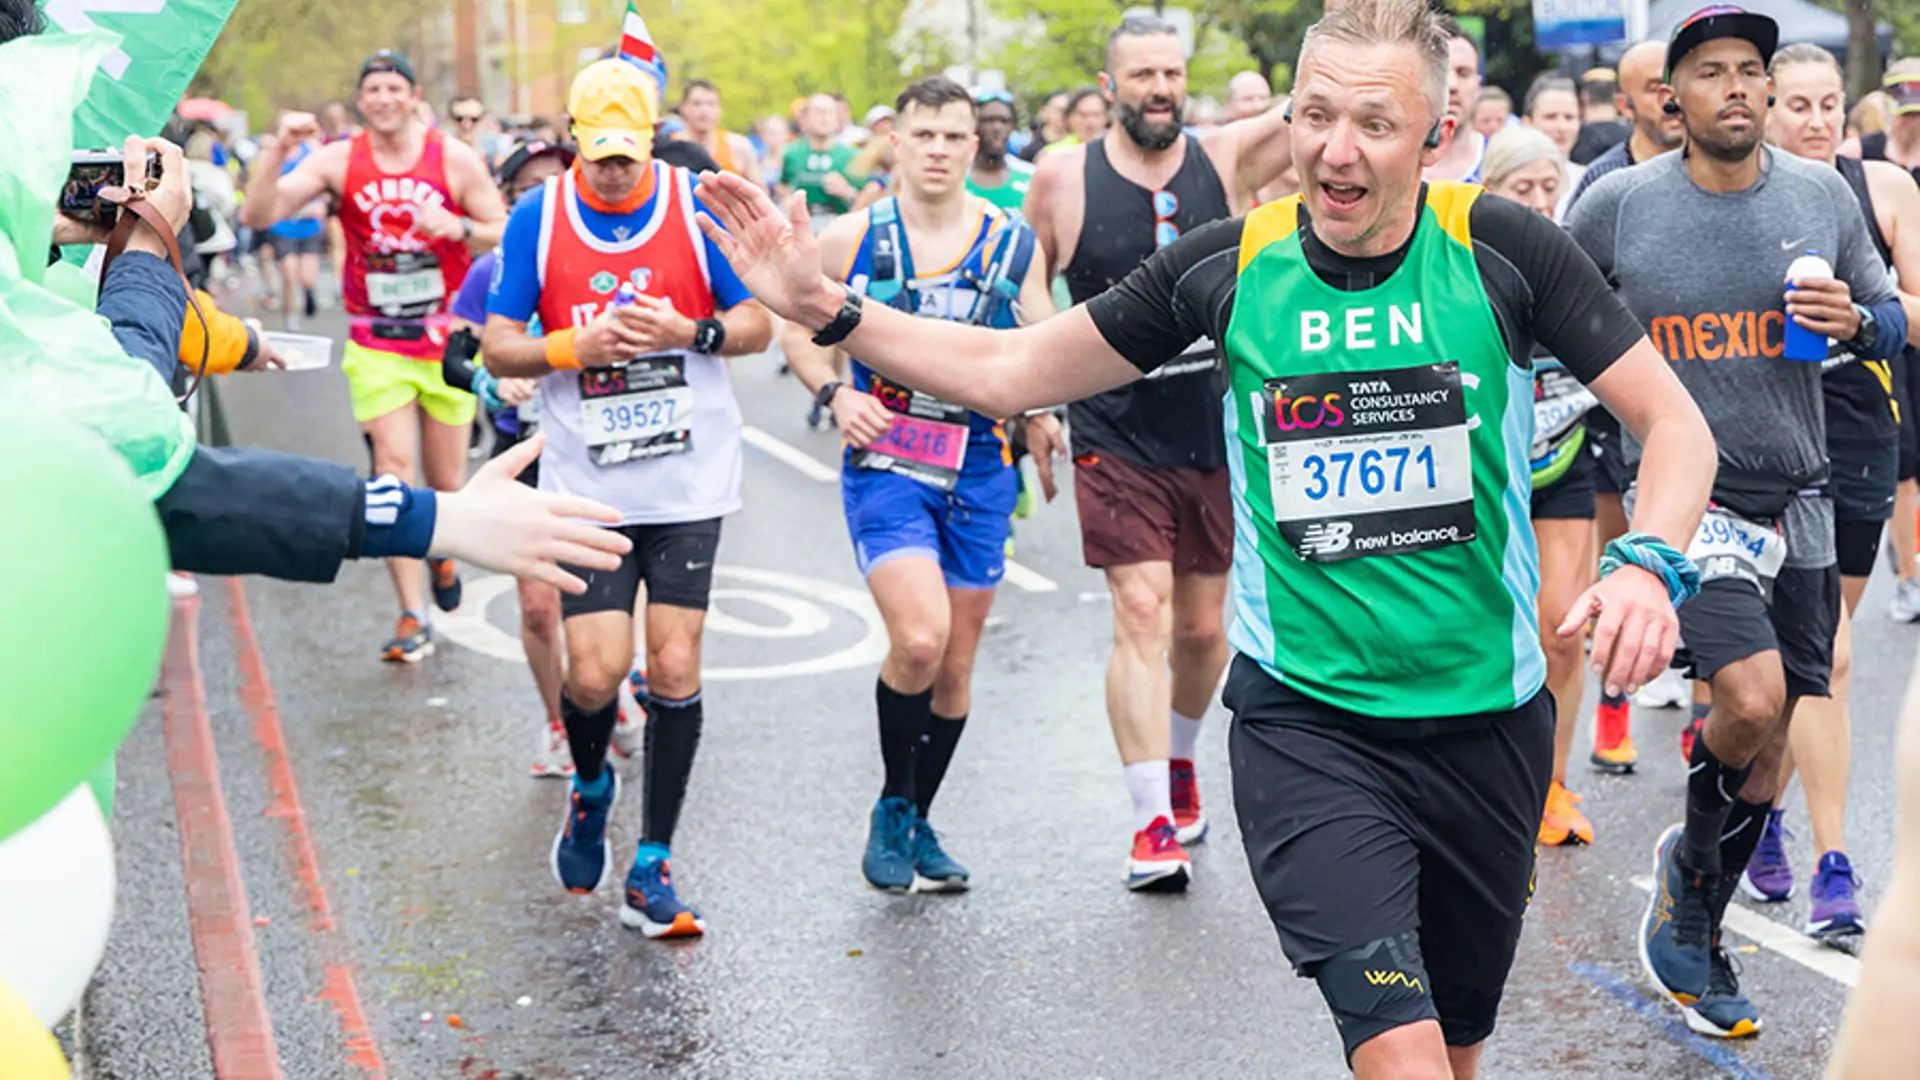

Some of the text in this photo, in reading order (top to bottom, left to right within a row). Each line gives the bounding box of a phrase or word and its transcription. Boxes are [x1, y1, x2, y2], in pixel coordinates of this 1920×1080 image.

[1300, 302, 1423, 352] BEN
[1651, 309, 1785, 361] MEXIC
[1348, 380, 1392, 394] TATA
[1350, 389, 1450, 410] CONSULTANCY
[602, 399, 676, 432] 39527
[1274, 389, 1345, 432] tcs
[1352, 407, 1416, 425] SERVICES
[877, 424, 948, 457] 4216
[1303, 445, 1437, 500] 37671
[1355, 525, 1459, 550] new balance
